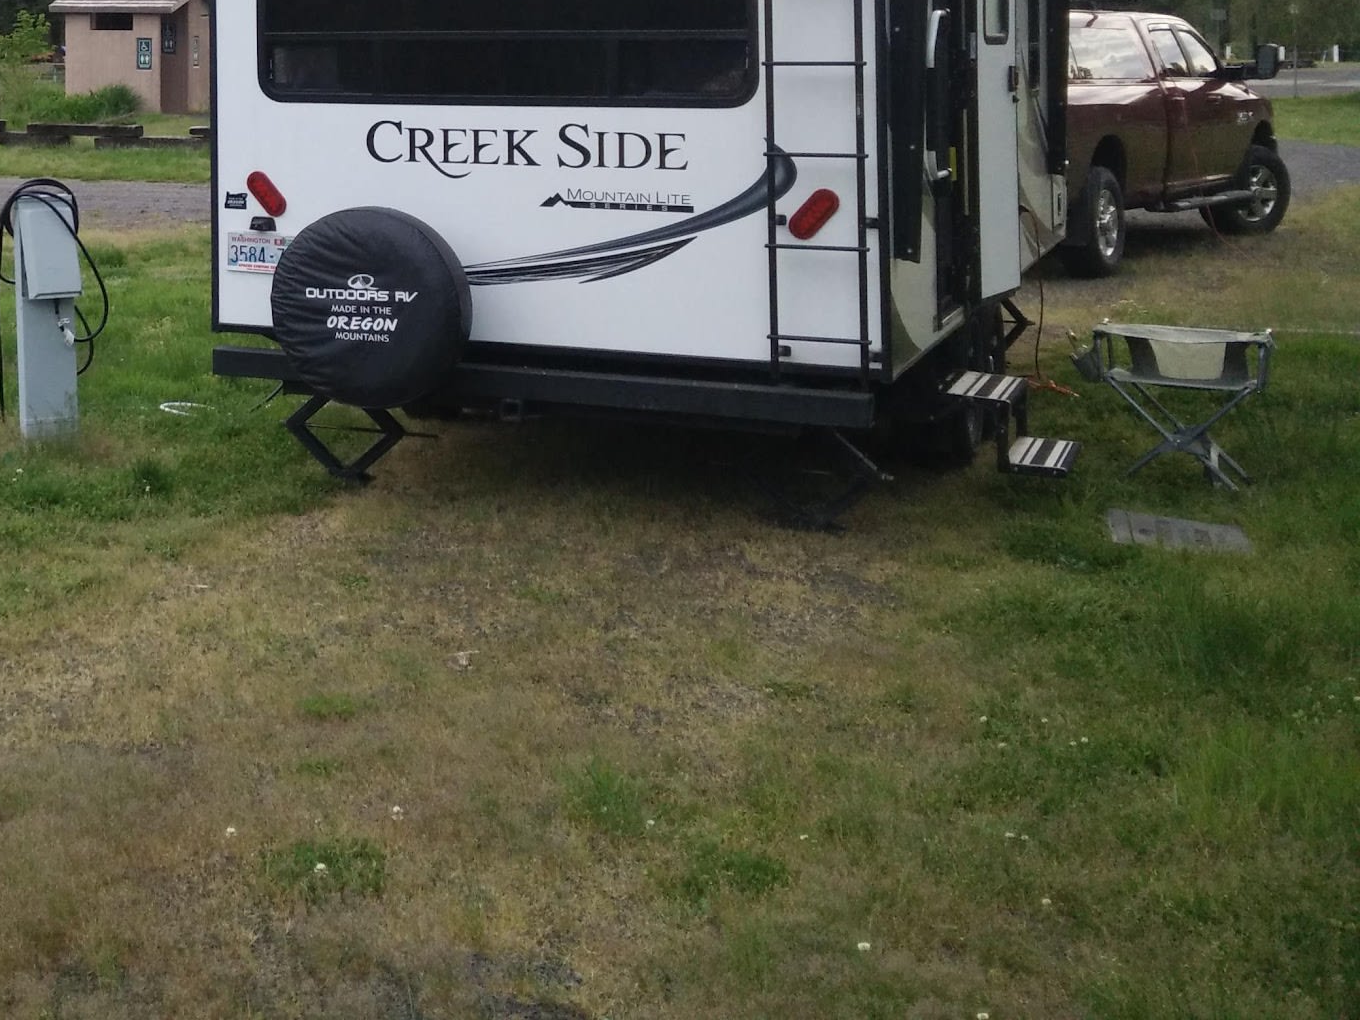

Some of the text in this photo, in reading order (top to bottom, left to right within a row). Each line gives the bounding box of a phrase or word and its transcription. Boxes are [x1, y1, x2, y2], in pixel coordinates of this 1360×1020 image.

[366, 120, 689, 179] CREEK SIDE
[567, 188, 691, 205] MOUNTAIN LITE
[590, 202, 668, 212] SERIES
[231, 235, 271, 245] WASHINGTON
[305, 287, 418, 302] OUTDOORS RV
[331, 305, 392, 315] MADE IN THE
[327, 315, 398, 331] OREGON
[335, 332, 390, 342] MOUNTAINS
